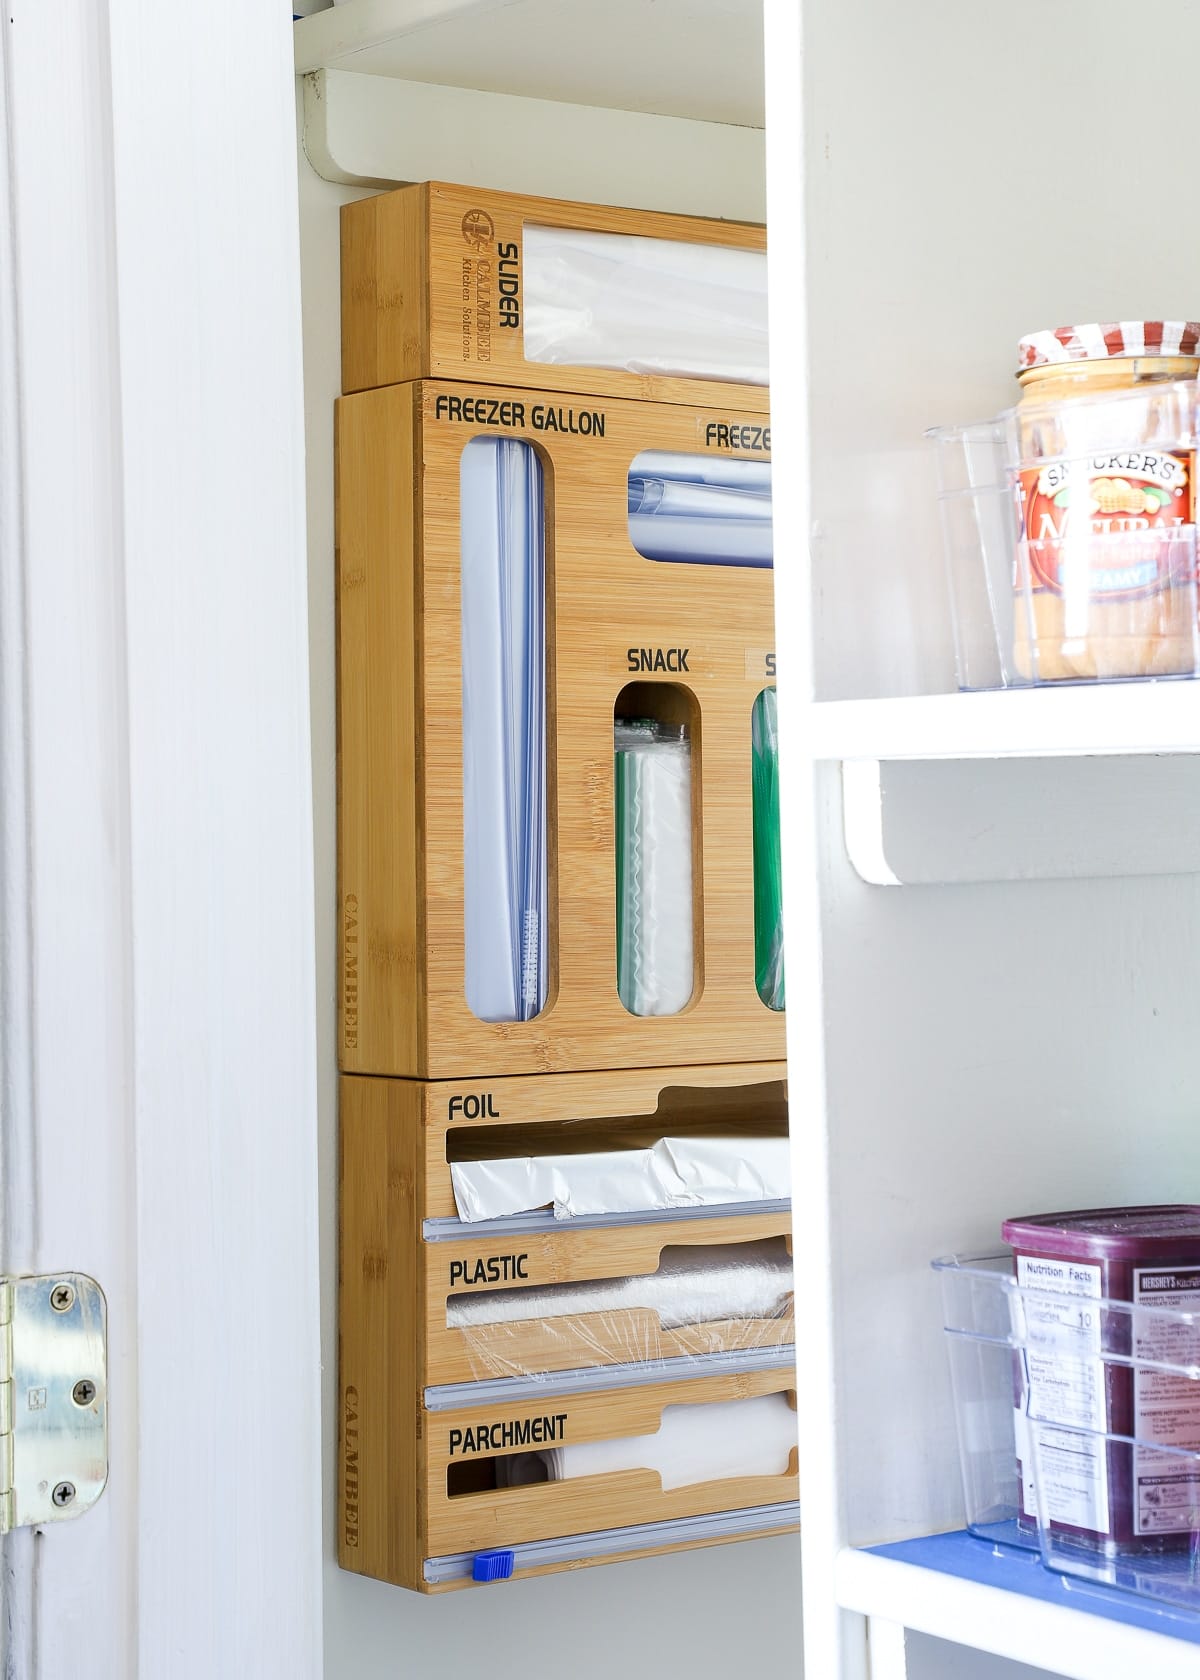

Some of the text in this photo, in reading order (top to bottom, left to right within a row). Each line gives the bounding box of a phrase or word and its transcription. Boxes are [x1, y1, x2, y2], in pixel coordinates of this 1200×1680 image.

[462, 258, 472, 302] Kitchen
[497, 242, 519, 329] SLIDER
[476, 259, 491, 362] CALMBEE
[436, 395, 605, 437] FREEZER GALLON
[706, 423, 771, 451] FREEZE
[627, 648, 690, 672] SNACK
[344, 892, 359, 1049] CALMBEE
[448, 1093, 500, 1121] FOIL
[450, 1253, 529, 1287] PLASTIC
[1026, 1262, 1093, 1282] Nutrition Facts
[1079, 1311, 1093, 1328] 10
[449, 1413, 568, 1456] PARCHMENT
[344, 1384, 359, 1548] CALMBEE
